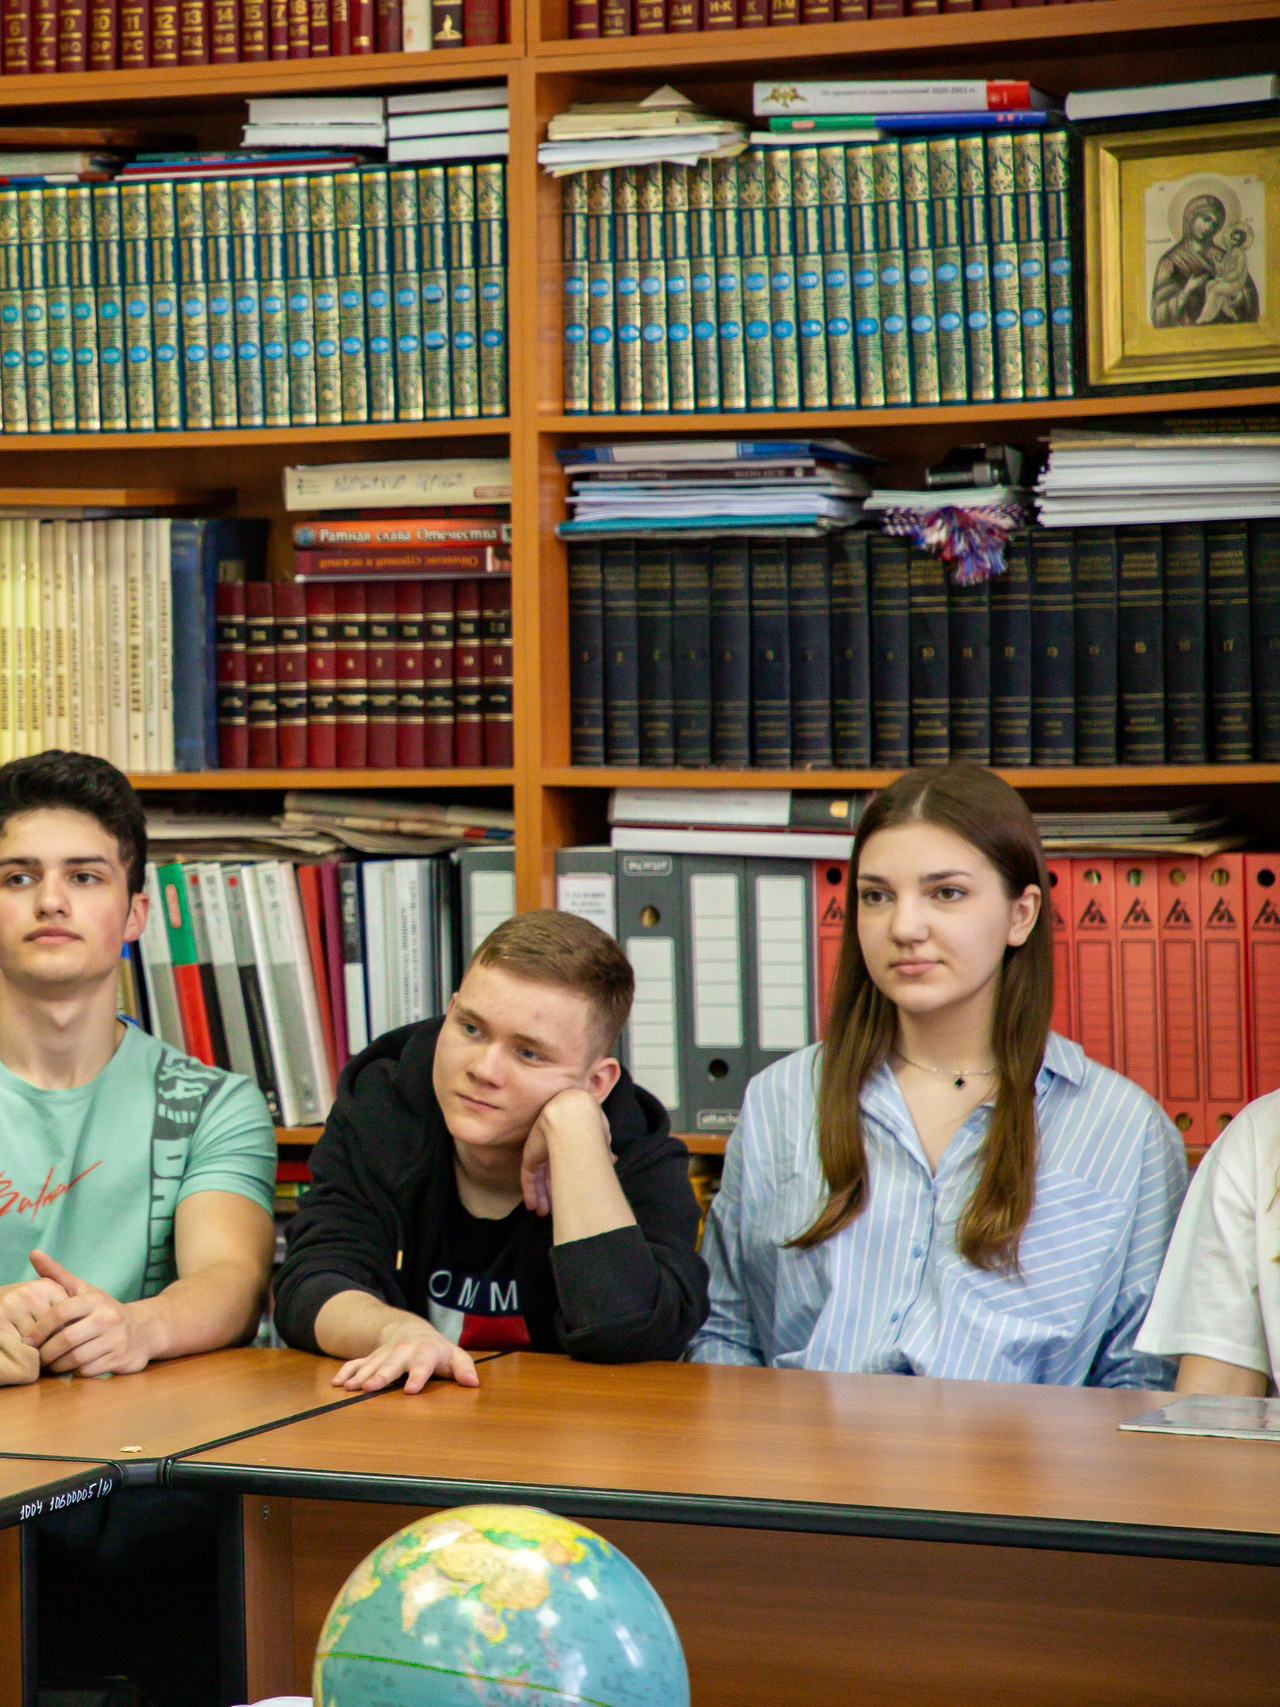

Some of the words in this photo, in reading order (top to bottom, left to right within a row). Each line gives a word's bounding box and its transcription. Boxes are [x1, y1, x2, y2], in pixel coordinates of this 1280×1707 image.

[184, 9, 202, 25] 13
[216, 8, 234, 22] 14
[244, 5, 261, 20] 15
[9, 20, 21, 36] 6
[39, 21, 52, 36] 7
[93, 15, 111, 31] 10
[125, 15, 141, 29] 11
[157, 14, 174, 29] 12
[319, 527, 371, 543] Ратная
[375, 529, 412, 542] слава
[415, 527, 497, 543] Отечества
[19, 1499, 43, 1521] 1004
